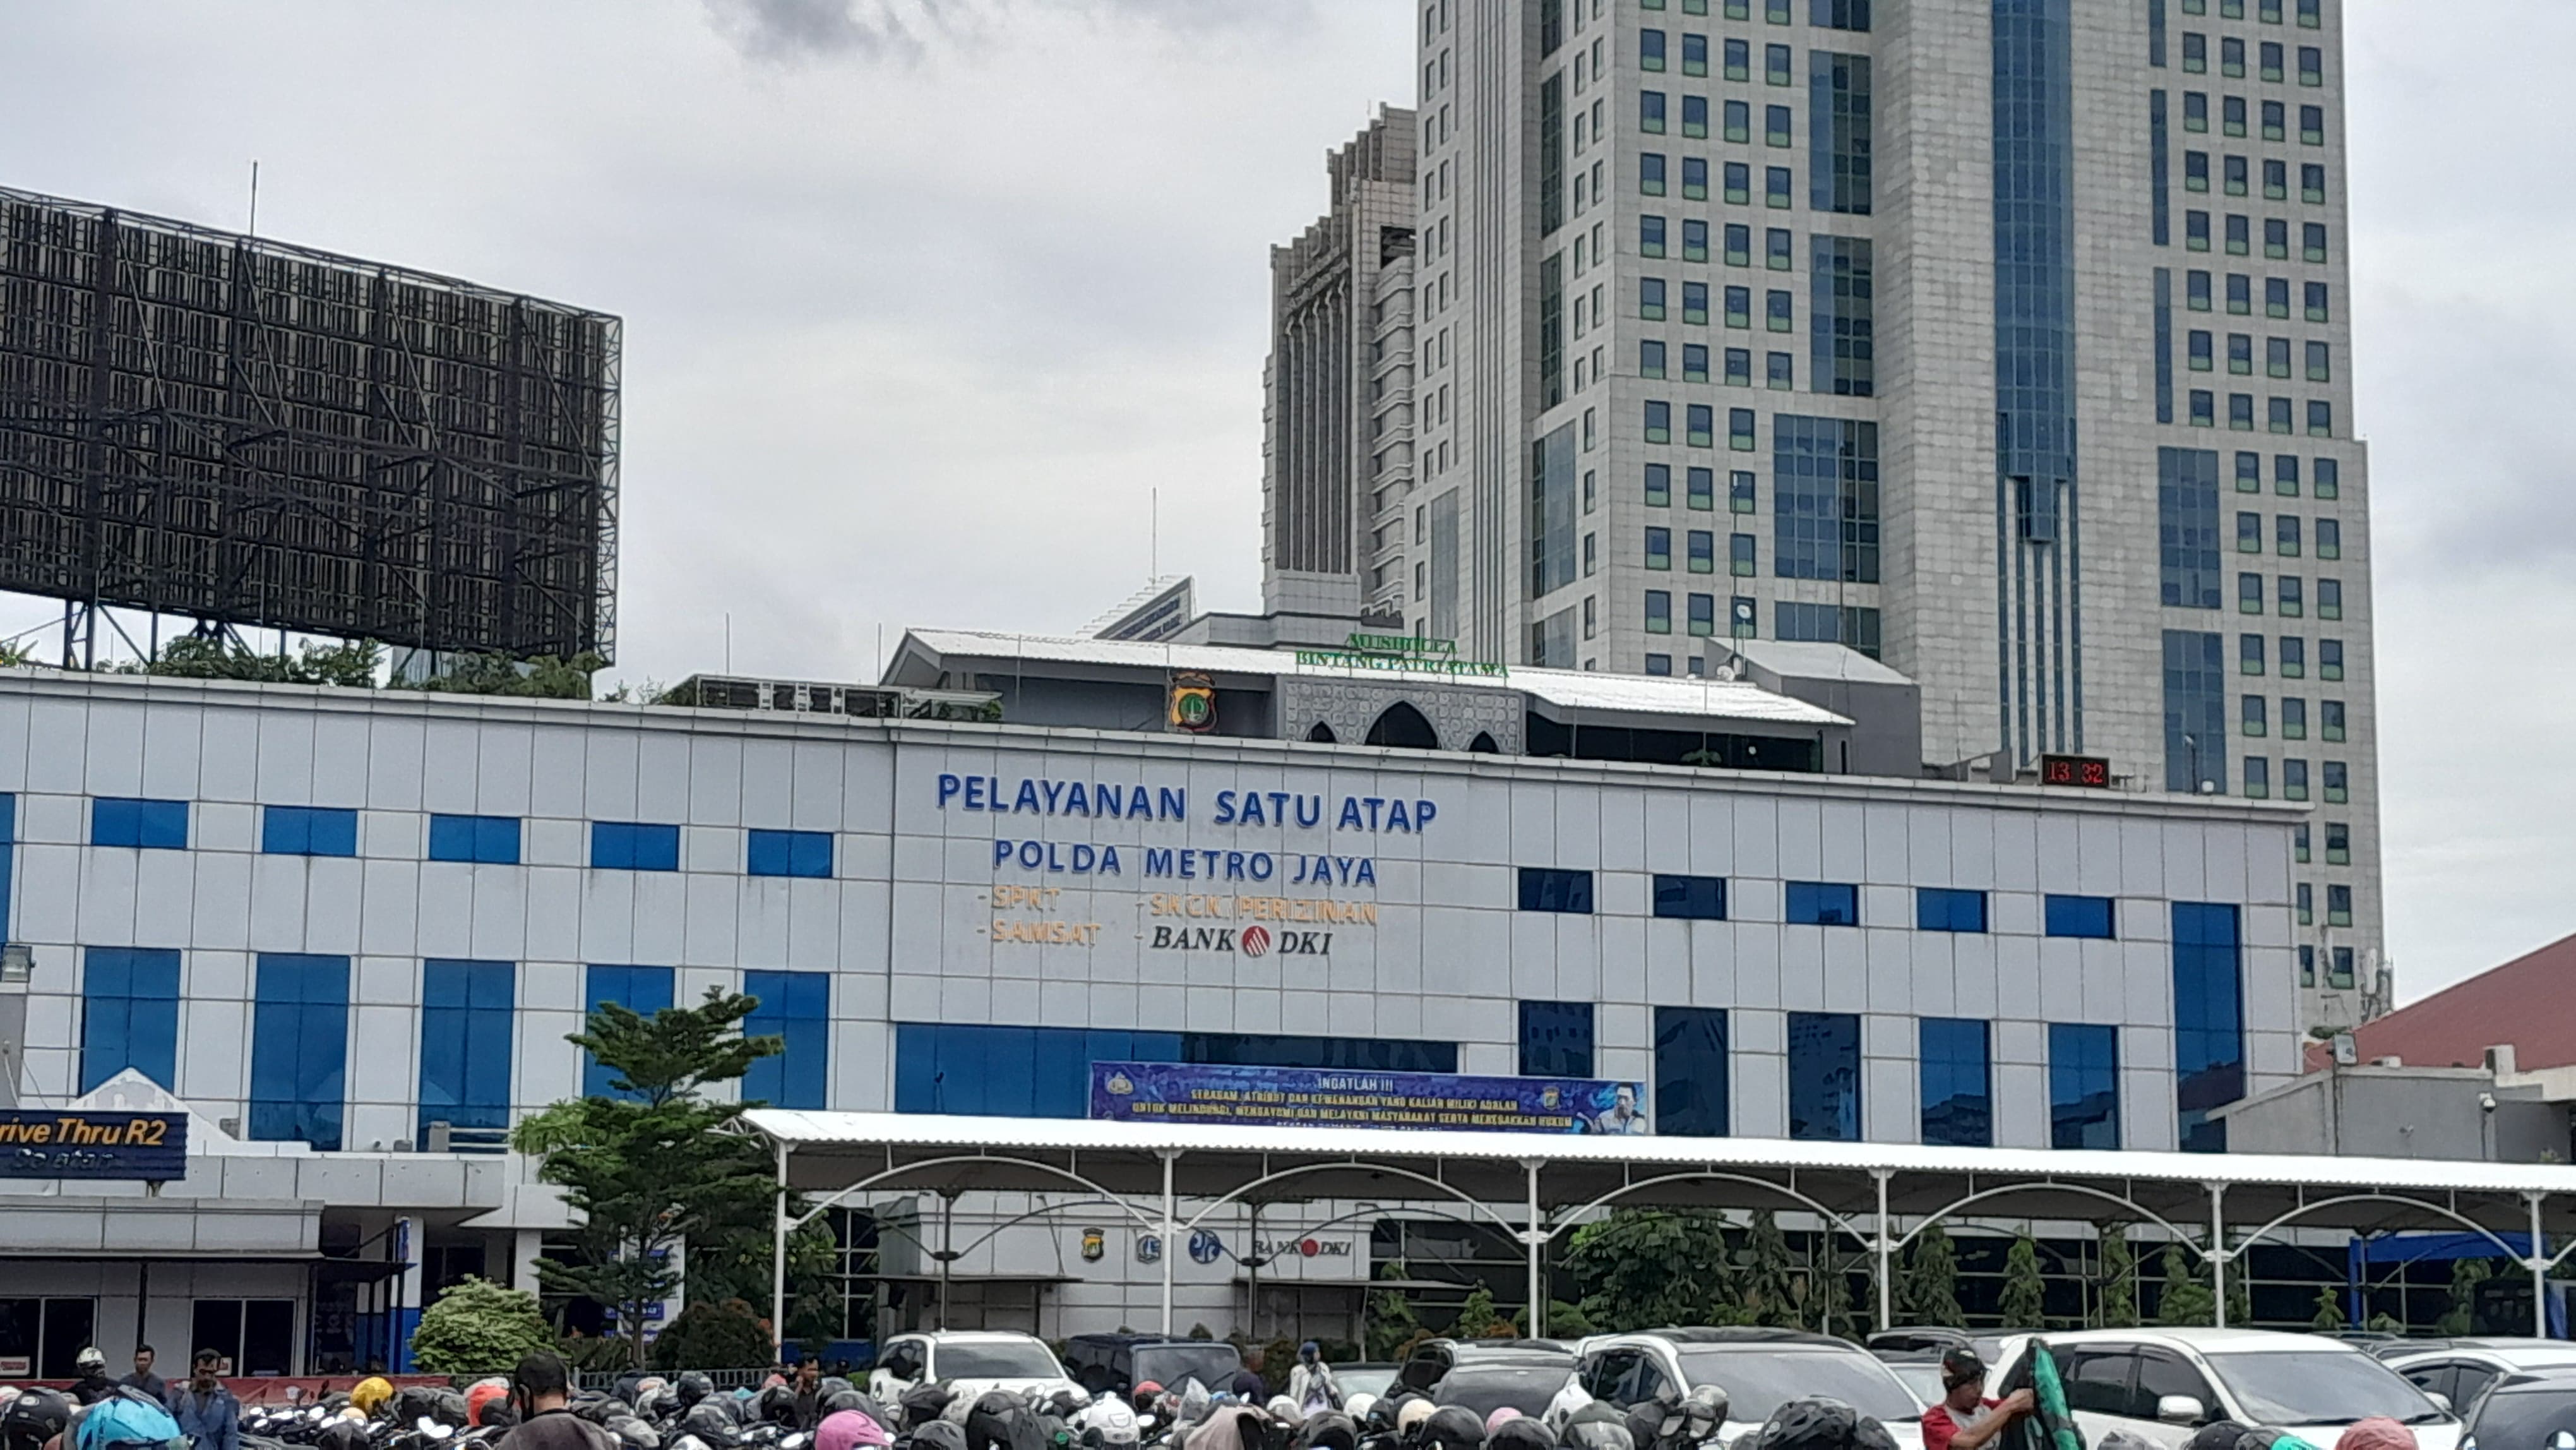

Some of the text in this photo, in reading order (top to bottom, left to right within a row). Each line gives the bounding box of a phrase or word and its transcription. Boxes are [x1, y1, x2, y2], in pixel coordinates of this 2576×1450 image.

[937, 773, 1437, 835] PELAYANAN SATU ATAP
[994, 839, 1377, 886] POLDA METRO JAYA
[1150, 925, 1334, 956] BANK DKI
[1318, 1077, 1376, 1091] INGATLAH
[0, 1117, 167, 1146] rive Thru R2
[1319, 1241, 1351, 1256] DKI
